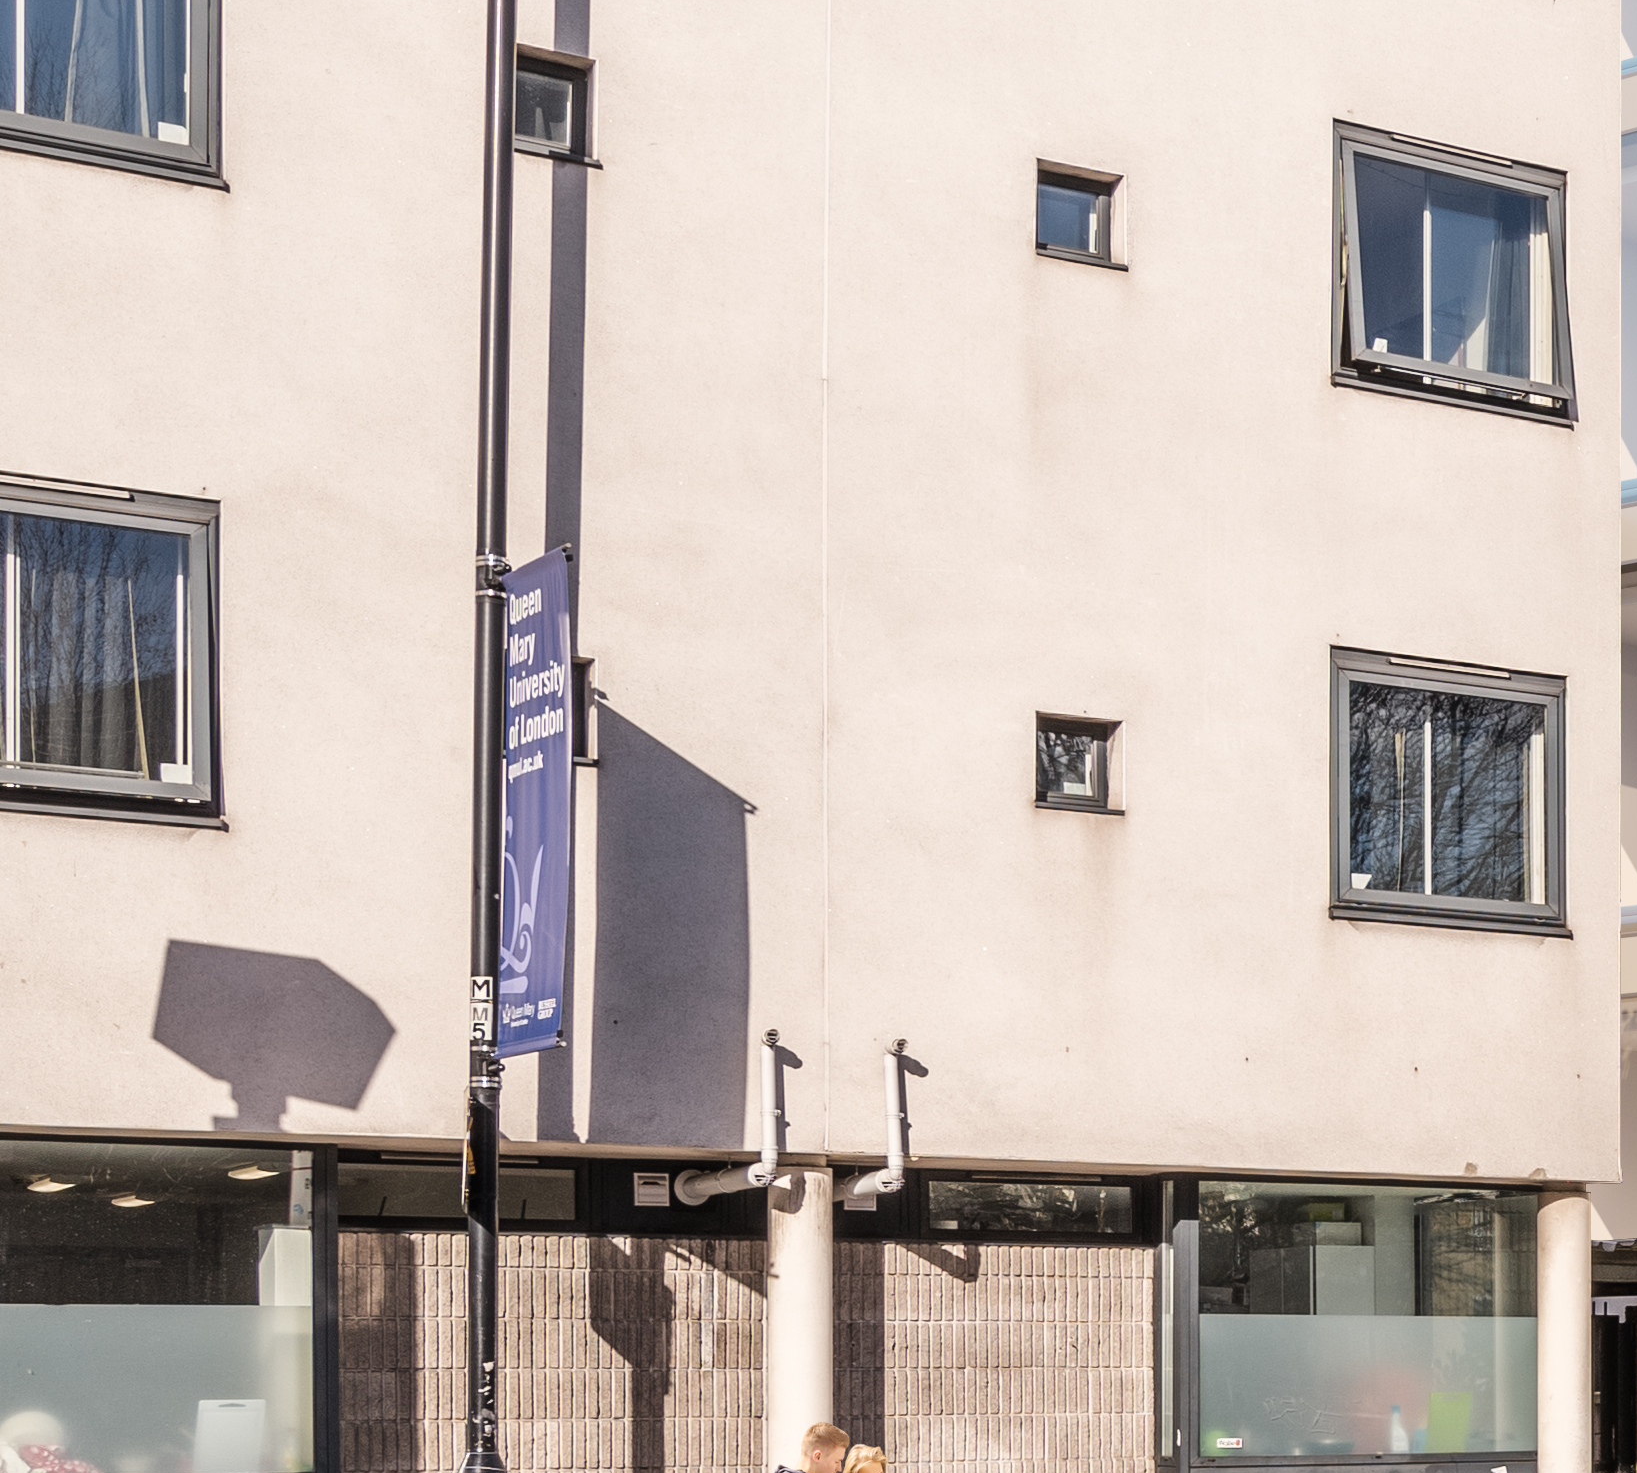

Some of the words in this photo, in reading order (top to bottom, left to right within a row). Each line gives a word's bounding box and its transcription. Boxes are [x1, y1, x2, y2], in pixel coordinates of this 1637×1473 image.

[509, 588, 542, 625] Queen
[509, 633, 536, 667] Mary
[509, 660, 565, 708] University
[509, 716, 520, 750] of
[520, 705, 564, 745] London
[472, 979, 491, 998] M
[472, 1022, 486, 1041] 5
